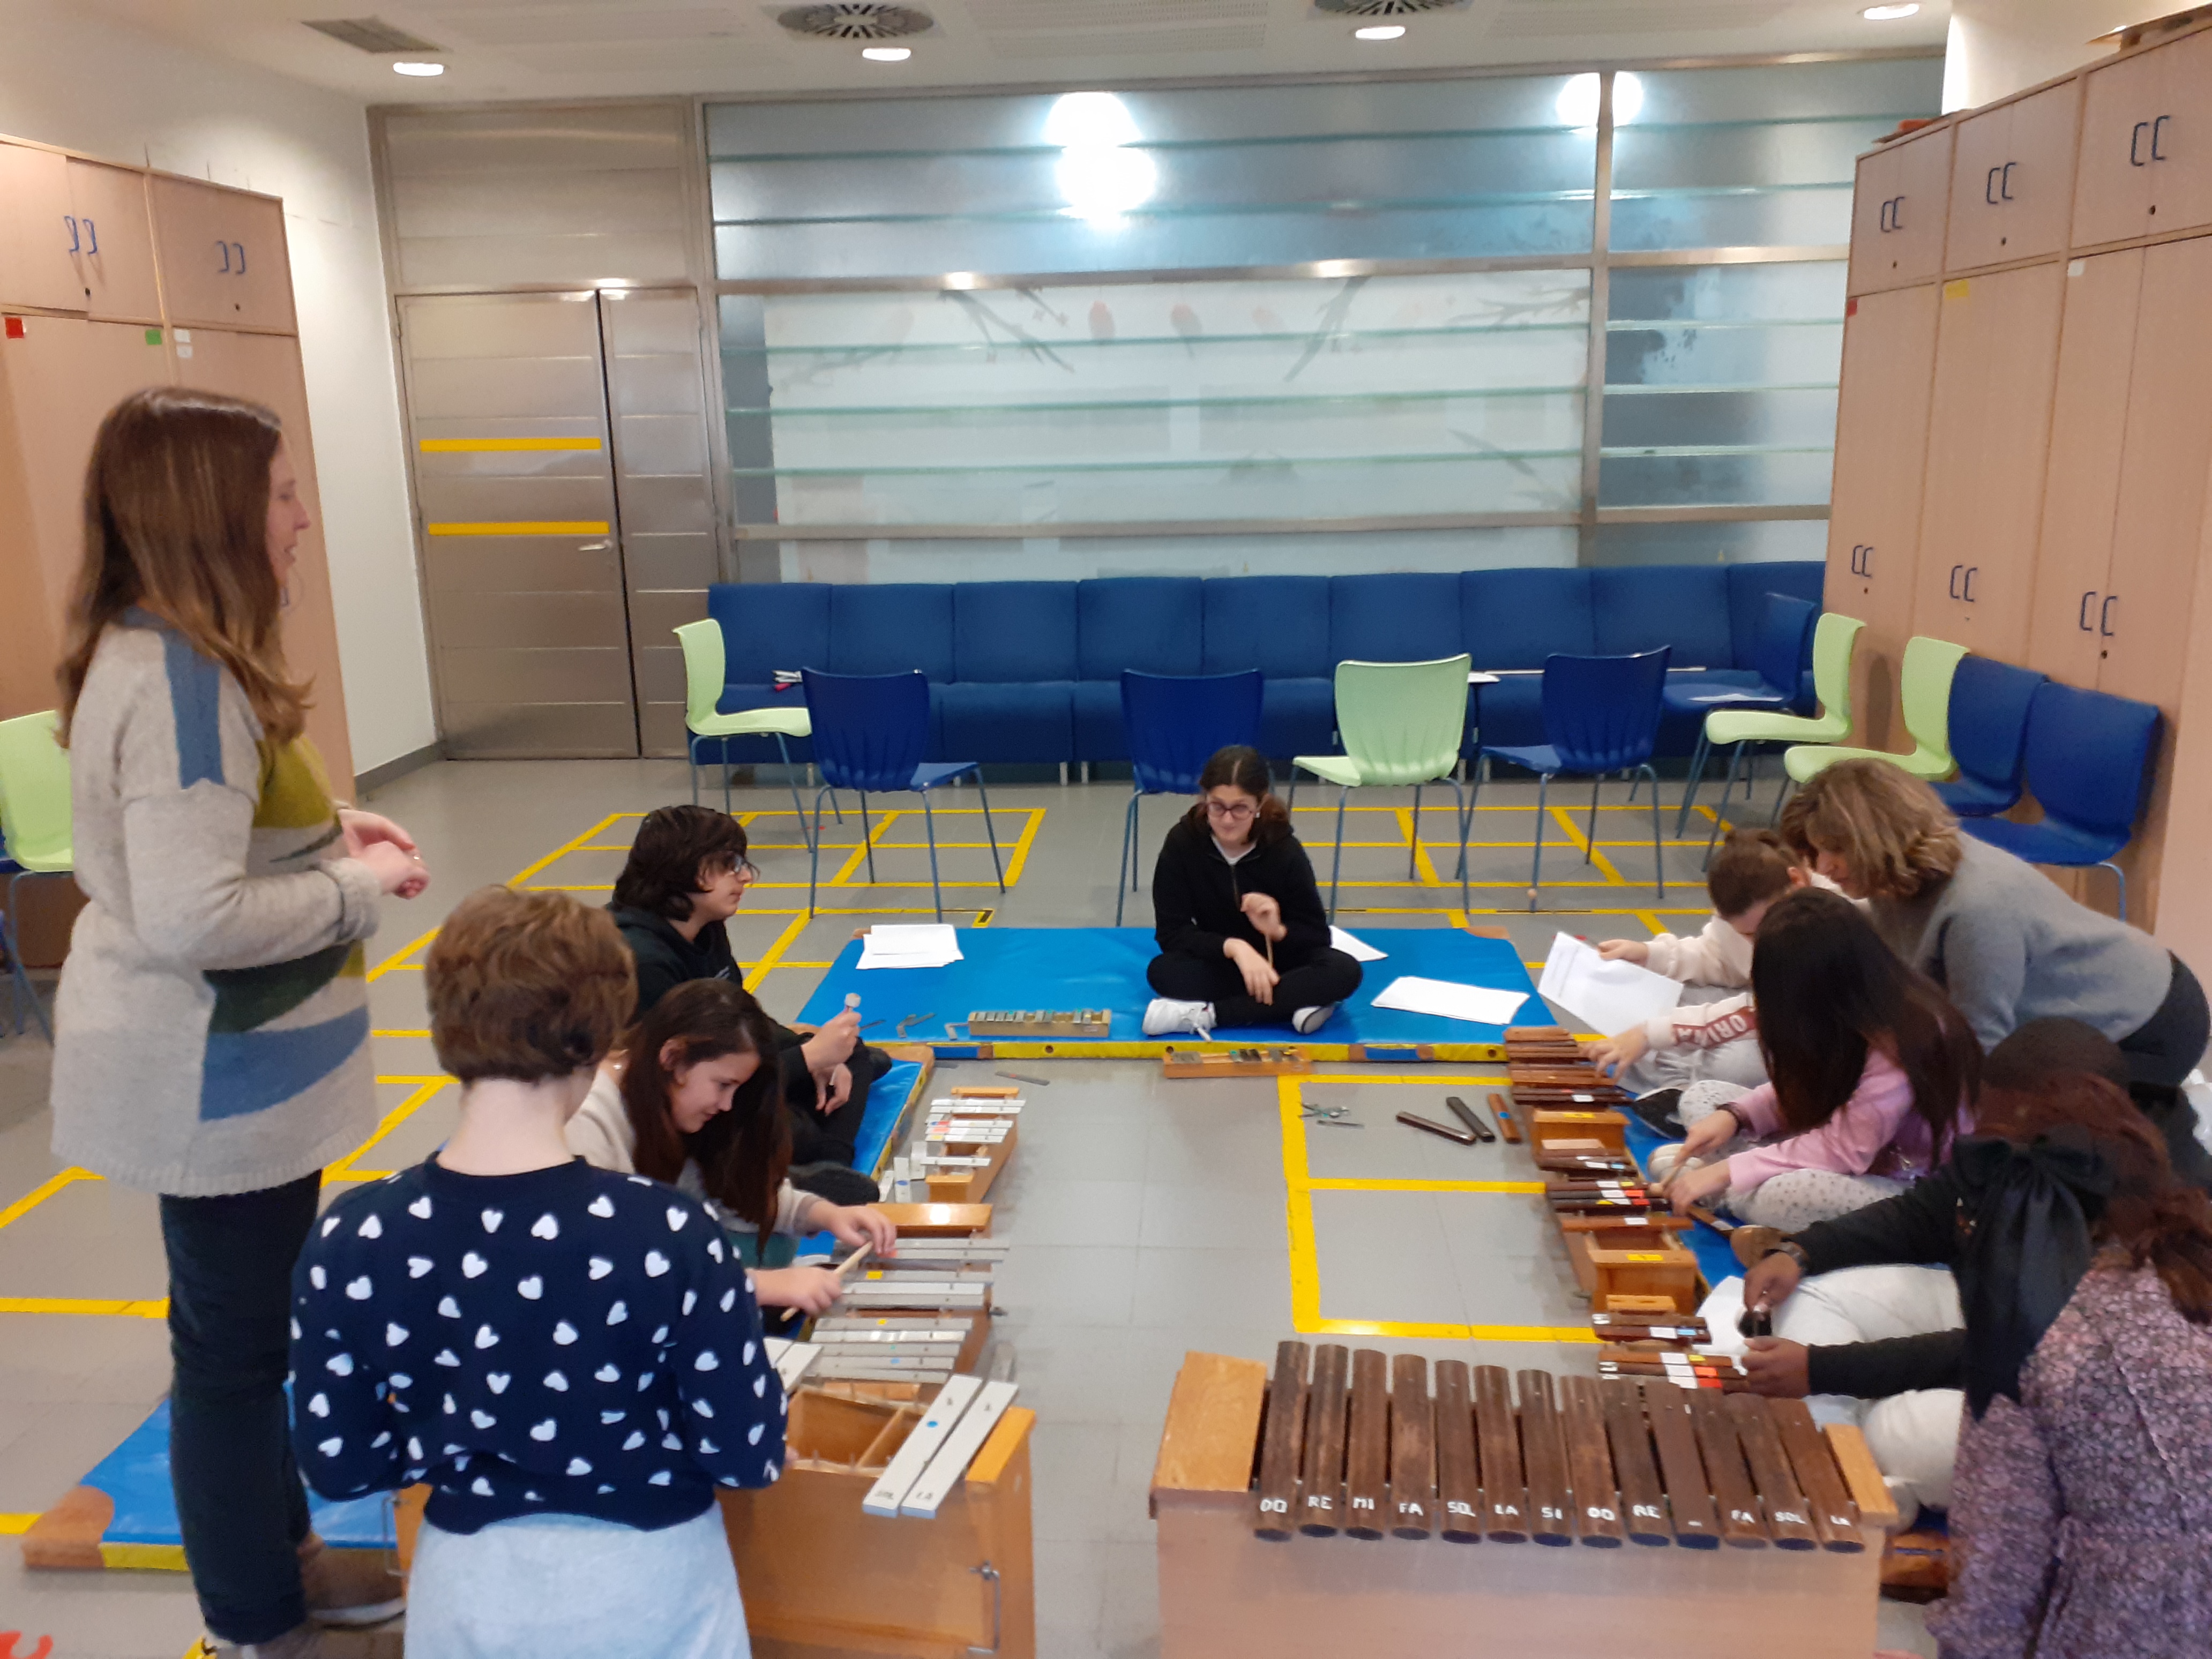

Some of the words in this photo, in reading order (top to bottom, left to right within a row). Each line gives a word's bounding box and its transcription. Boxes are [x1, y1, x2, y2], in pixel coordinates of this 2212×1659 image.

[1308, 1496, 1332, 1509] RE
[1399, 1503, 1423, 1516] FA
[1494, 1504, 1519, 1515] LA
[1541, 1507, 1563, 1520] SI
